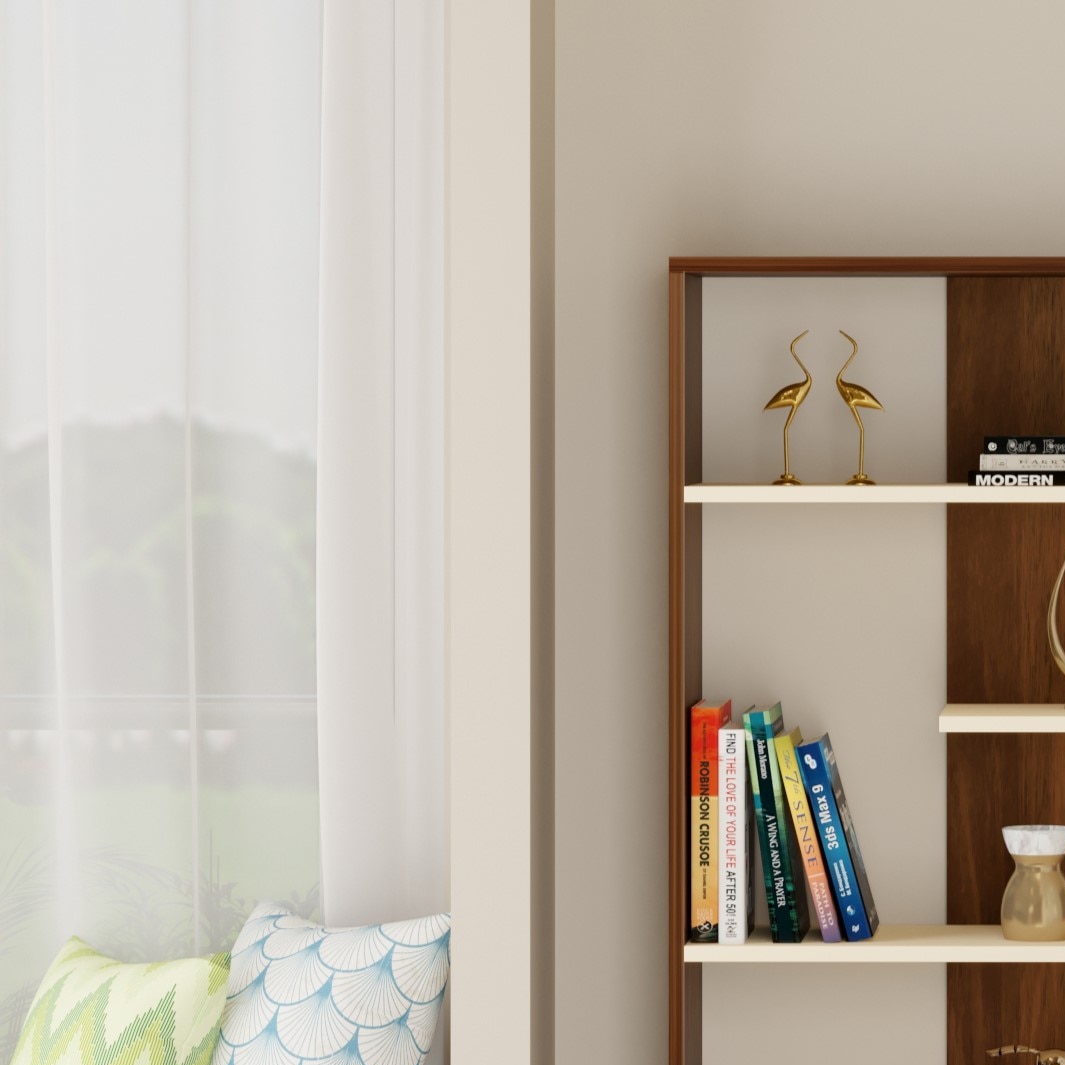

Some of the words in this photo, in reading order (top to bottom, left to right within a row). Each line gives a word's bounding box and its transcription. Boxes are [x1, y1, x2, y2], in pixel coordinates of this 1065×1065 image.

[1042, 439, 1065, 454] Eye
[975, 474, 1054, 486] MODERN
[726, 733, 736, 754] FIND
[757, 739, 766, 755] John
[726, 758, 736, 774] THE
[759, 755, 768, 779] Morano
[699, 761, 709, 820] ROBINSON
[726, 778, 736, 802] LOVE
[812, 784, 823, 793] 9
[726, 807, 736, 817] OF
[783, 750, 792, 769] The
[793, 800, 818, 867] SENSE
[817, 795, 832, 824] Max
[726, 819, 736, 846] YOUR
[767, 822, 779, 848] WING
[825, 826, 839, 850] 3ds
[699, 824, 709, 866] CRUSOE
[726, 849, 736, 868] LIFE
[771, 849, 781, 867] AND
[726, 870, 736, 901] AFTER
[774, 876, 786, 908] PRAYER
[812, 882, 828, 929] PARADISE
[819, 882, 830, 908] PATH
[826, 911, 834, 926] TO
